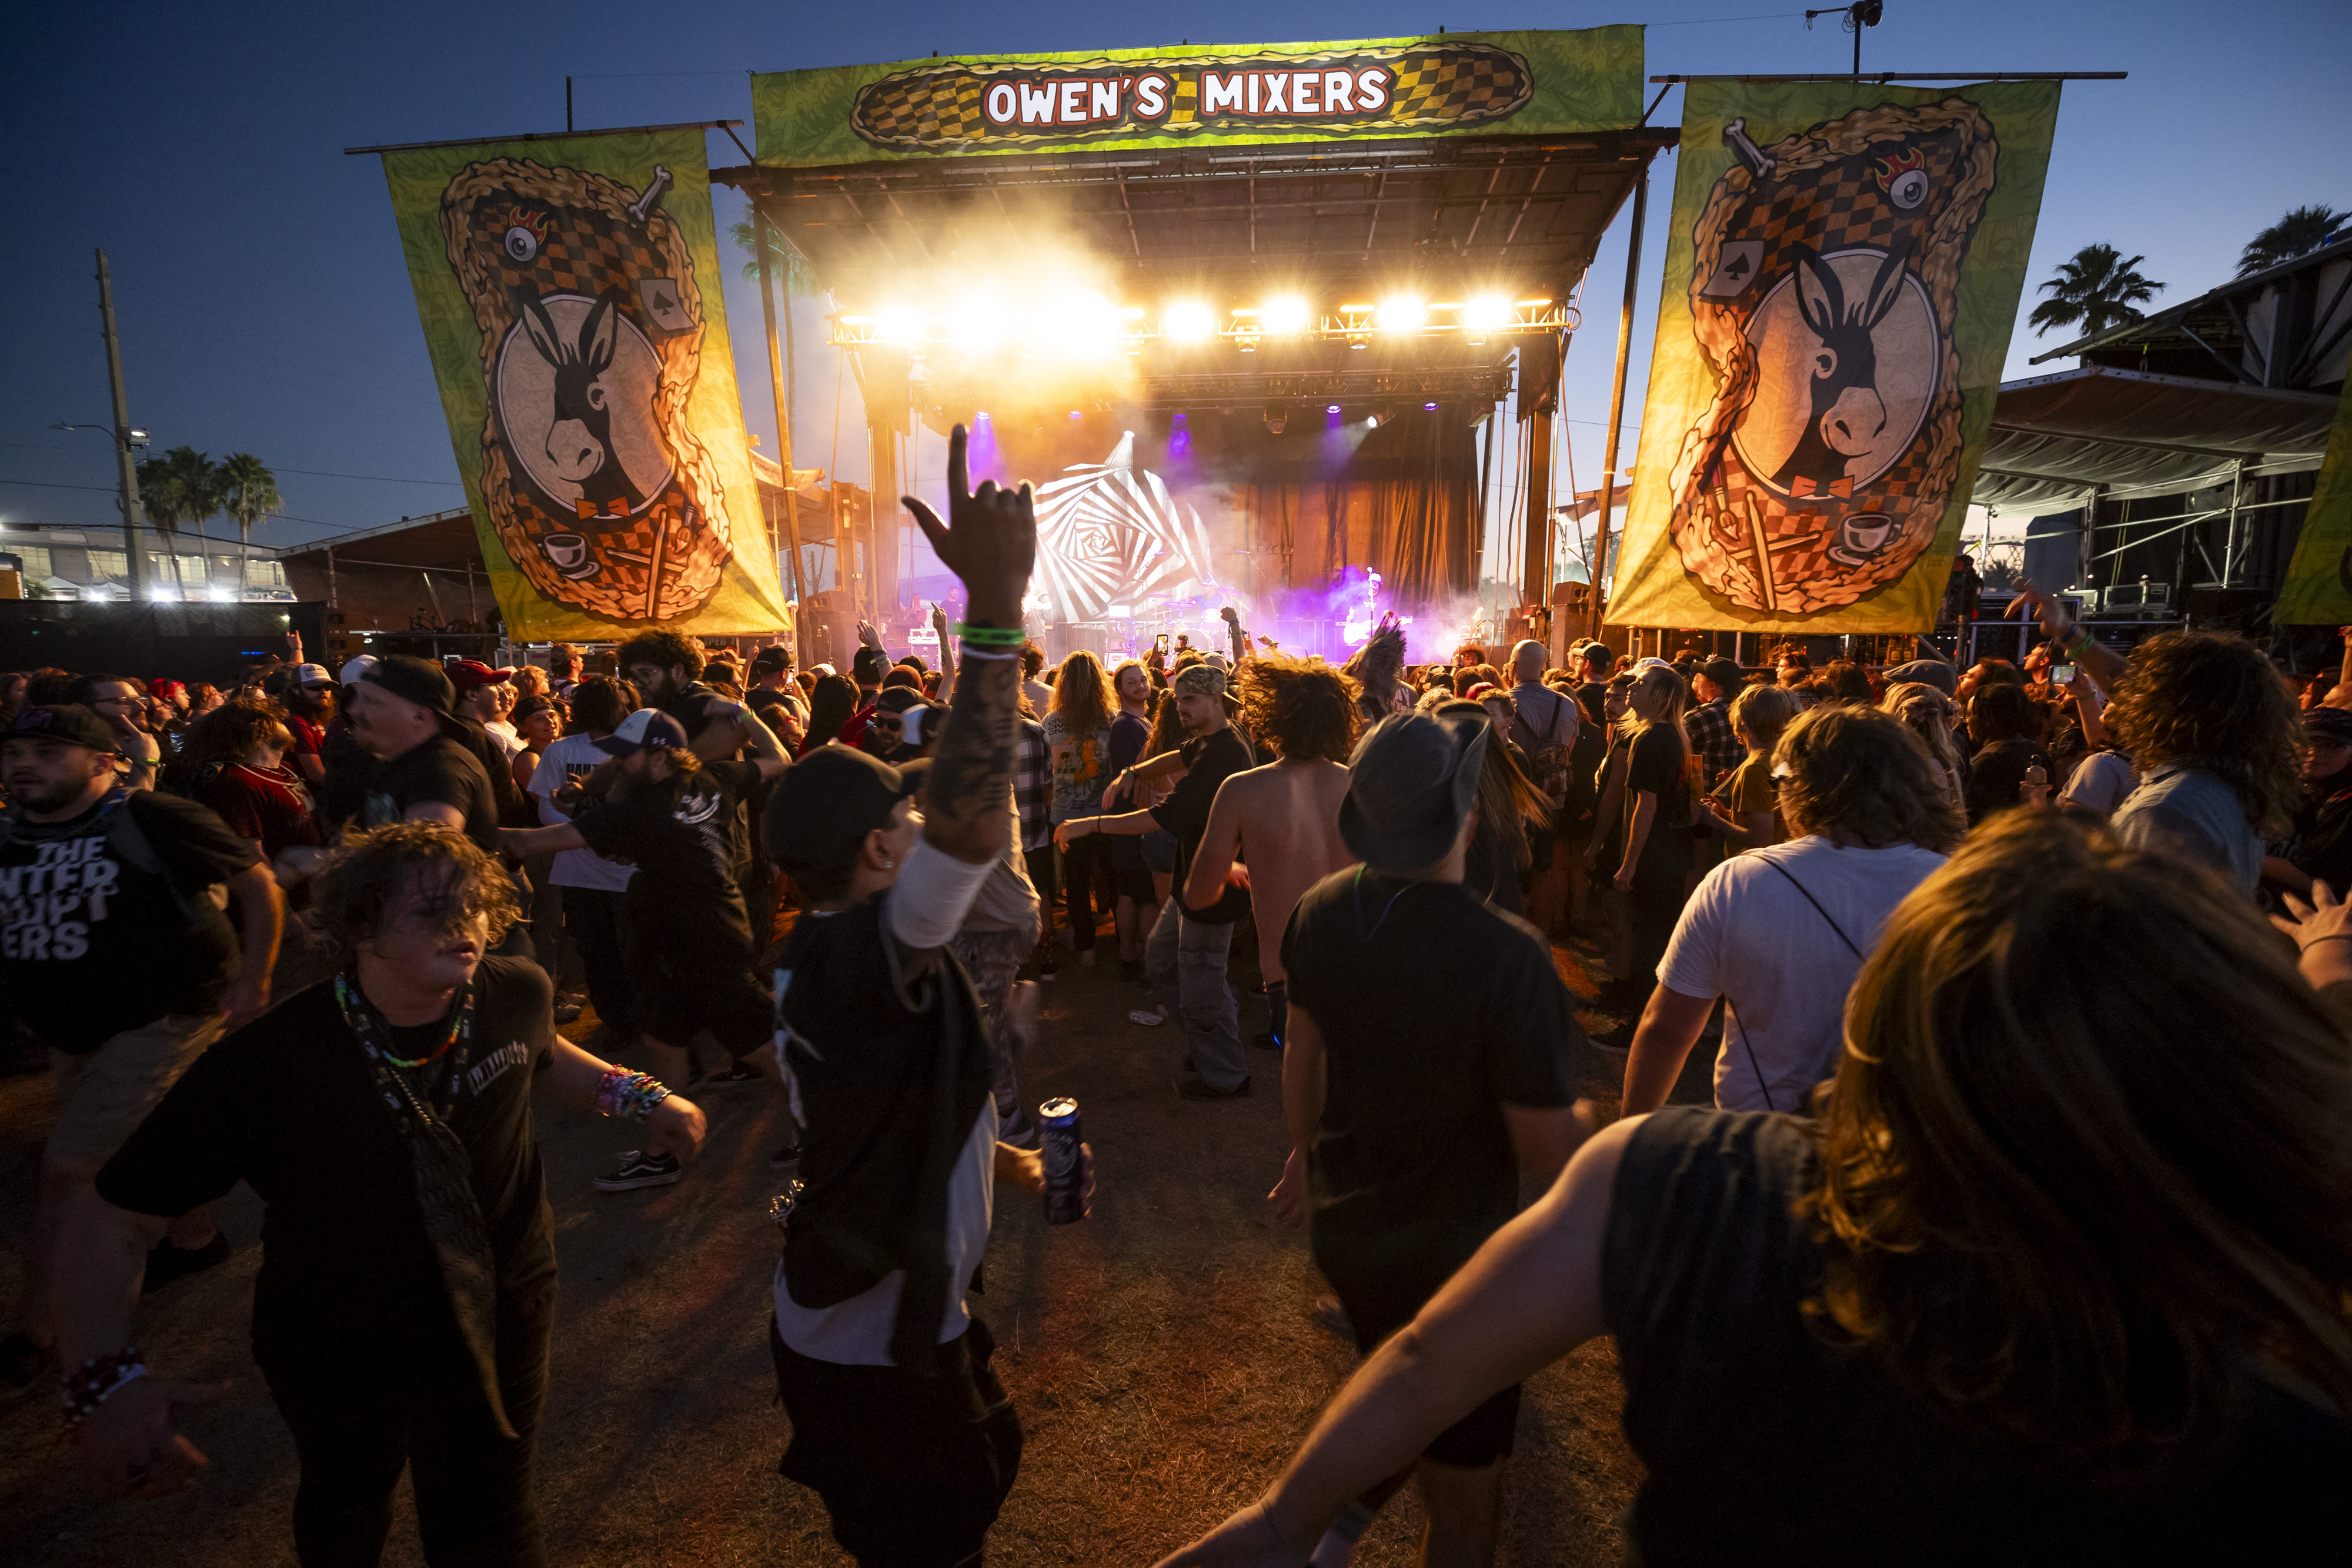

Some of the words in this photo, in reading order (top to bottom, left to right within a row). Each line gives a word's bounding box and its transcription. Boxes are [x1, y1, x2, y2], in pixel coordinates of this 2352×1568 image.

[988, 75, 1167, 123] OWEN'S
[1204, 69, 1388, 114] MIXERS
[36, 835, 107, 868] THE
[1, 920, 89, 961] ERS
